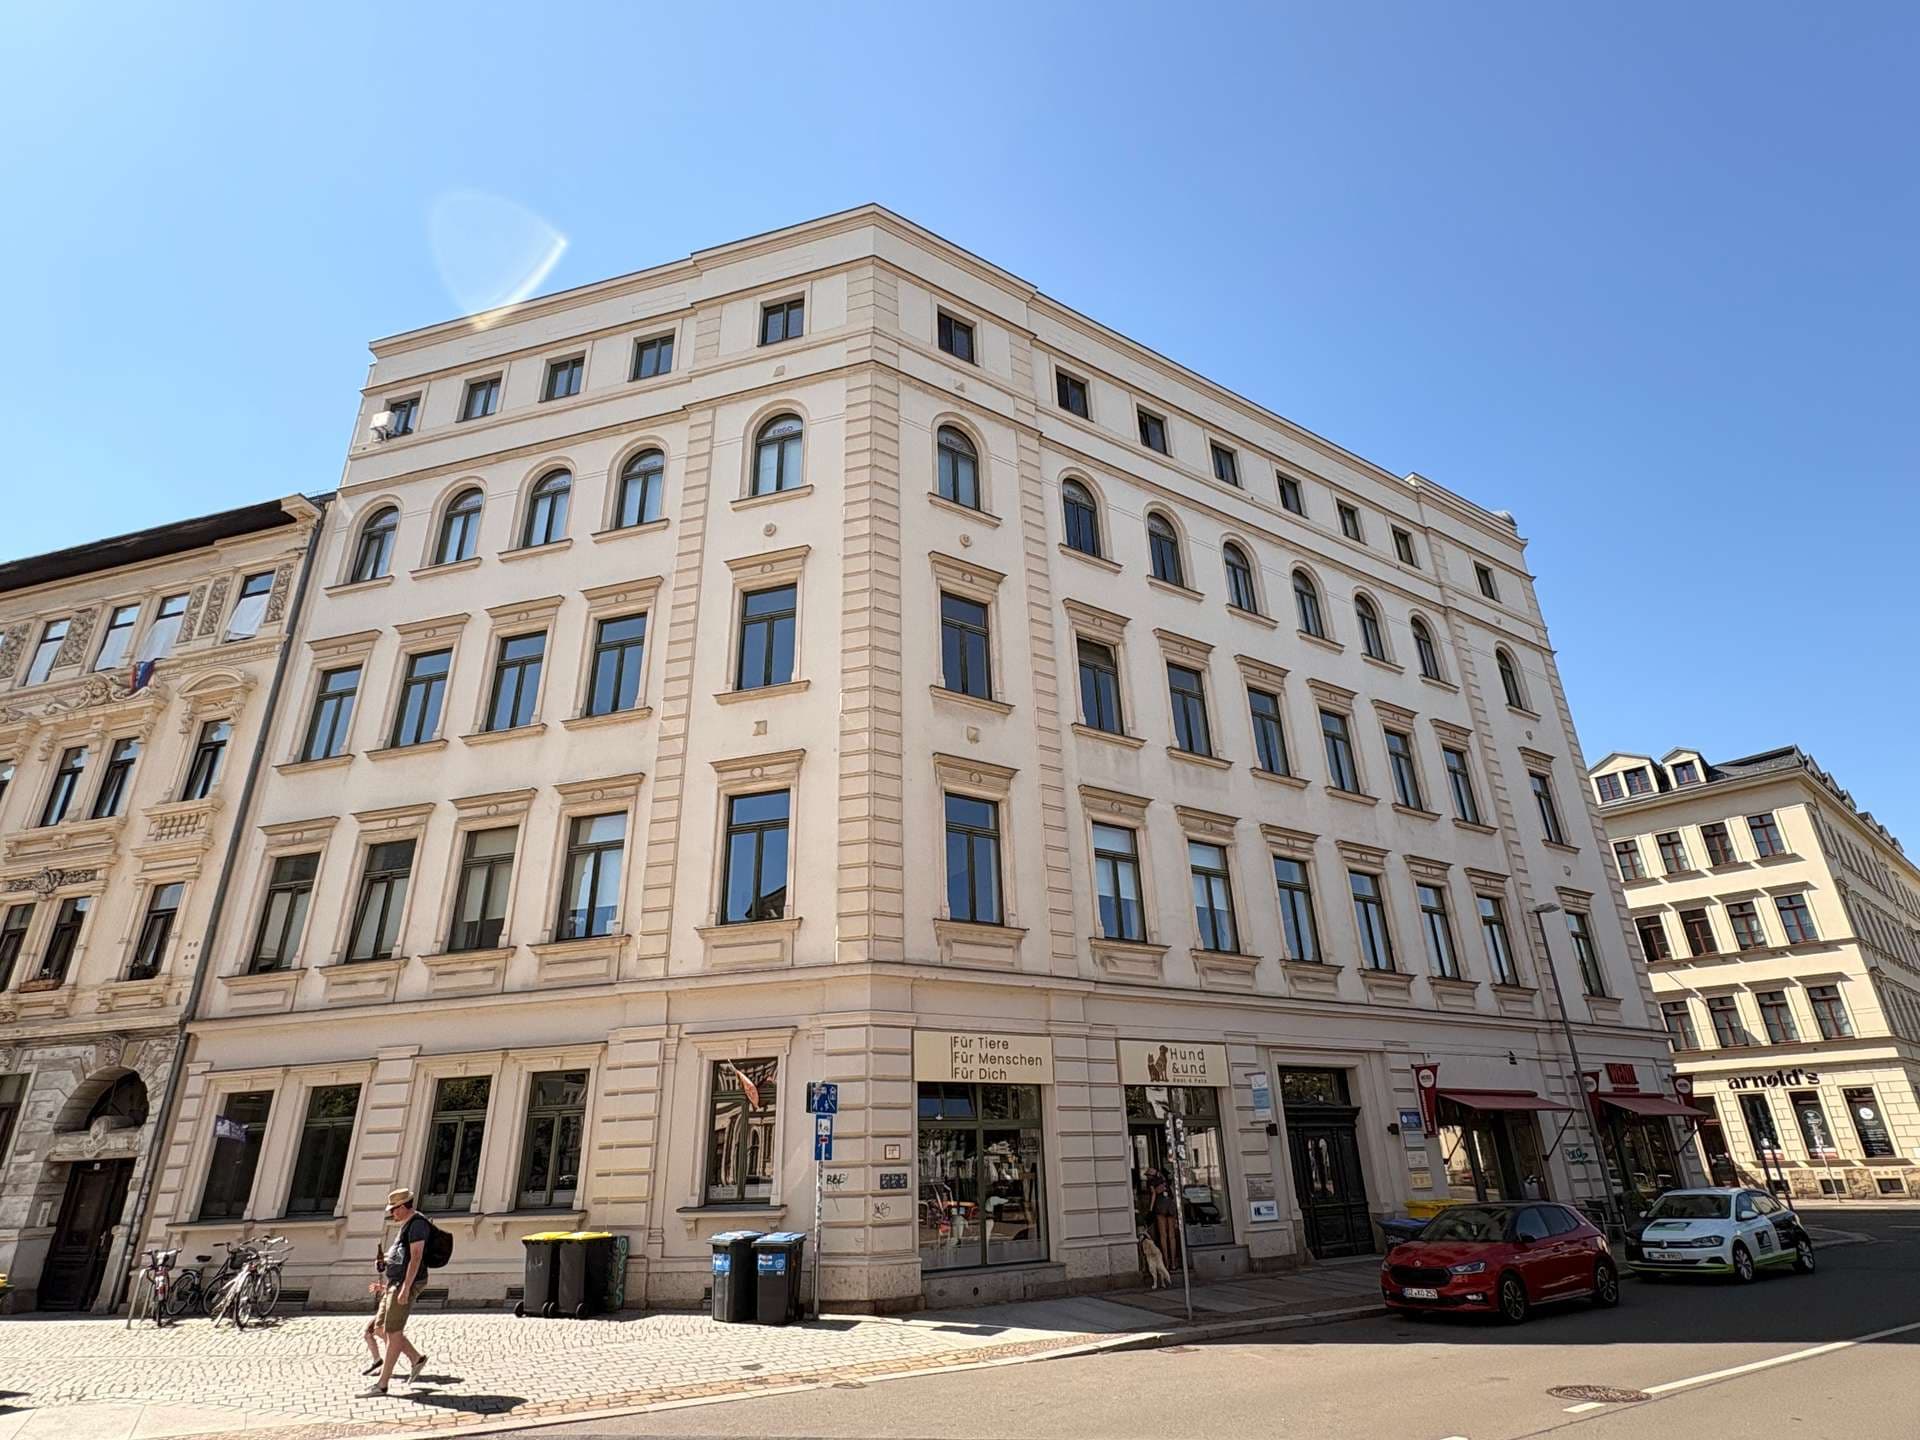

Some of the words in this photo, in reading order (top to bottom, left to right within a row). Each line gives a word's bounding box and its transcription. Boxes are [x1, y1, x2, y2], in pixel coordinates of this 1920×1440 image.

[953, 1035, 973, 1048] Für
[978, 1037, 1009, 1050] Tiere
[954, 1051, 974, 1064] Für
[979, 1053, 1043, 1066] Menschen
[1170, 1048, 1204, 1061] Hund
[954, 1067, 974, 1080] Für
[979, 1068, 1007, 1080] Dich
[1172, 1062, 1206, 1075] &und
[1728, 1069, 1820, 1089] arnold's
